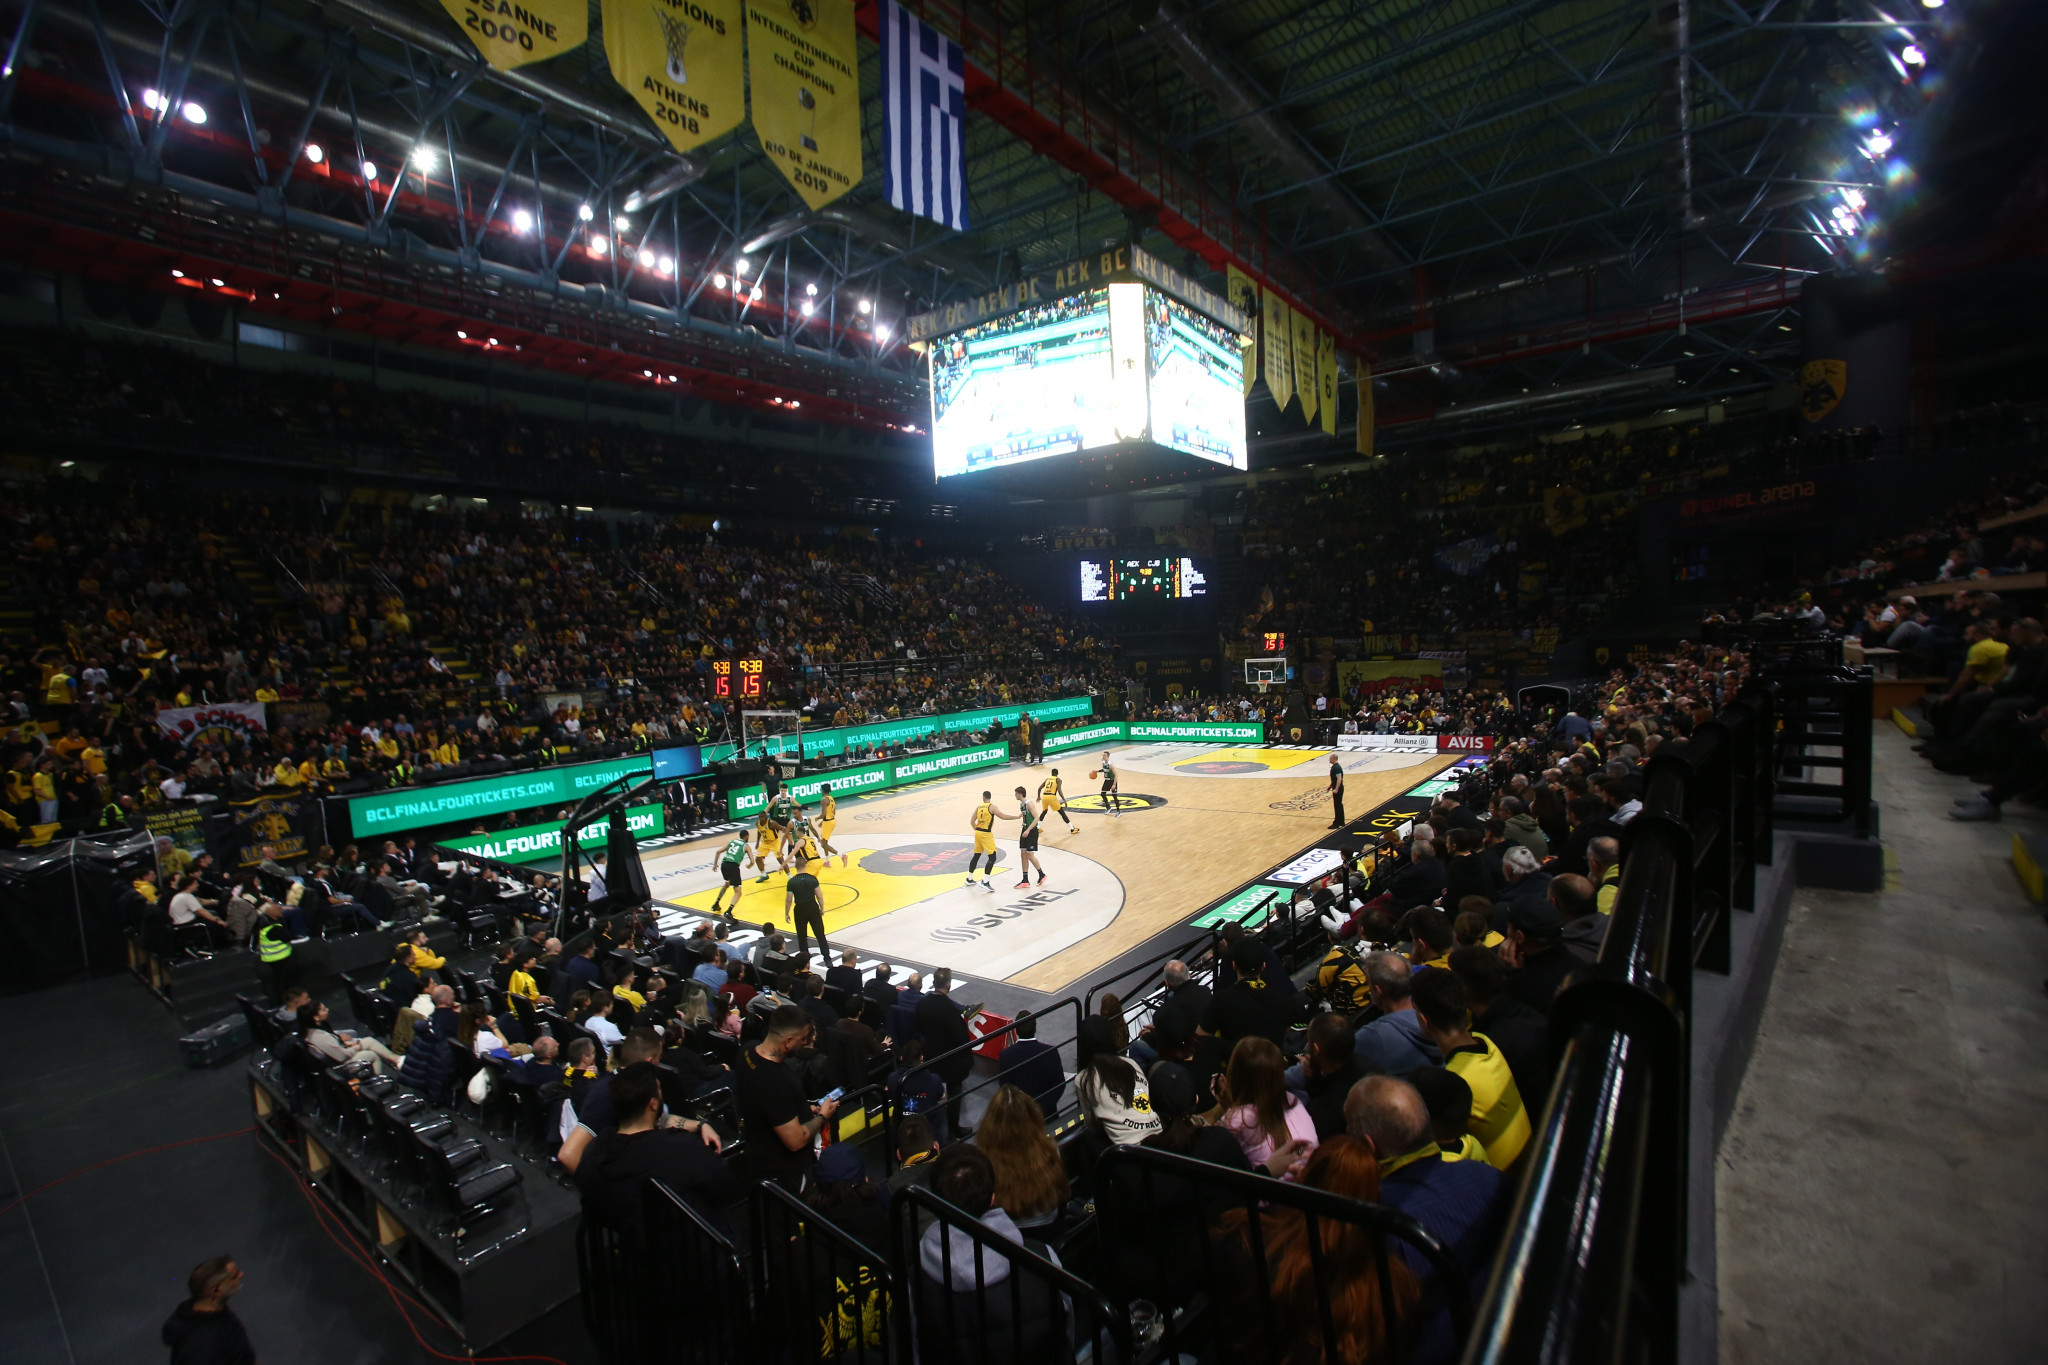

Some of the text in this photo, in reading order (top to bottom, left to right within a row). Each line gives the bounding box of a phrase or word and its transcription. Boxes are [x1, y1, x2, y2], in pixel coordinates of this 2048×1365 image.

[465, 7, 534, 52] 2000
[470, 0, 558, 42] SANNE
[750, 8, 853, 79] INTERCONTINENTAL
[794, 49, 815, 68] CUP
[774, 52, 835, 95] CHAMPIONS
[643, 75, 709, 119] ATHENS
[655, 101, 700, 135] 2018
[765, 140, 850, 187] RIO DE JANEIRO
[794, 166, 829, 194] 2019
[978, 287, 1008, 314] AEK
[1055, 261, 1090, 290] AEK
[1101, 248, 1126, 273] BC
[1135, 253, 1157, 281] AEK
[1325, 373, 1332, 399] 6
[1760, 481, 1816, 504] arena
[1265, 640, 1276, 650] 15
[713, 660, 762, 674] 9:38 9:38
[716, 675, 760, 695] 15 15
[847, 724, 935, 744] BCLFINALFOURTICKETS.COM
[1131, 726, 1257, 738] BCLFINALFOURTICKETS.COM
[1394, 736, 1418, 745] Allianz
[1448, 736, 1485, 749] AVIS
[896, 748, 1005, 778] BCLFINALFOURTICKETS.COM
[1045, 780, 1054, 789] 21
[366, 781, 555, 822] BCLFINALFOURTICKETS.COM
[728, 842, 740, 856] 24
[966, 888, 1081, 929] SUNEL
